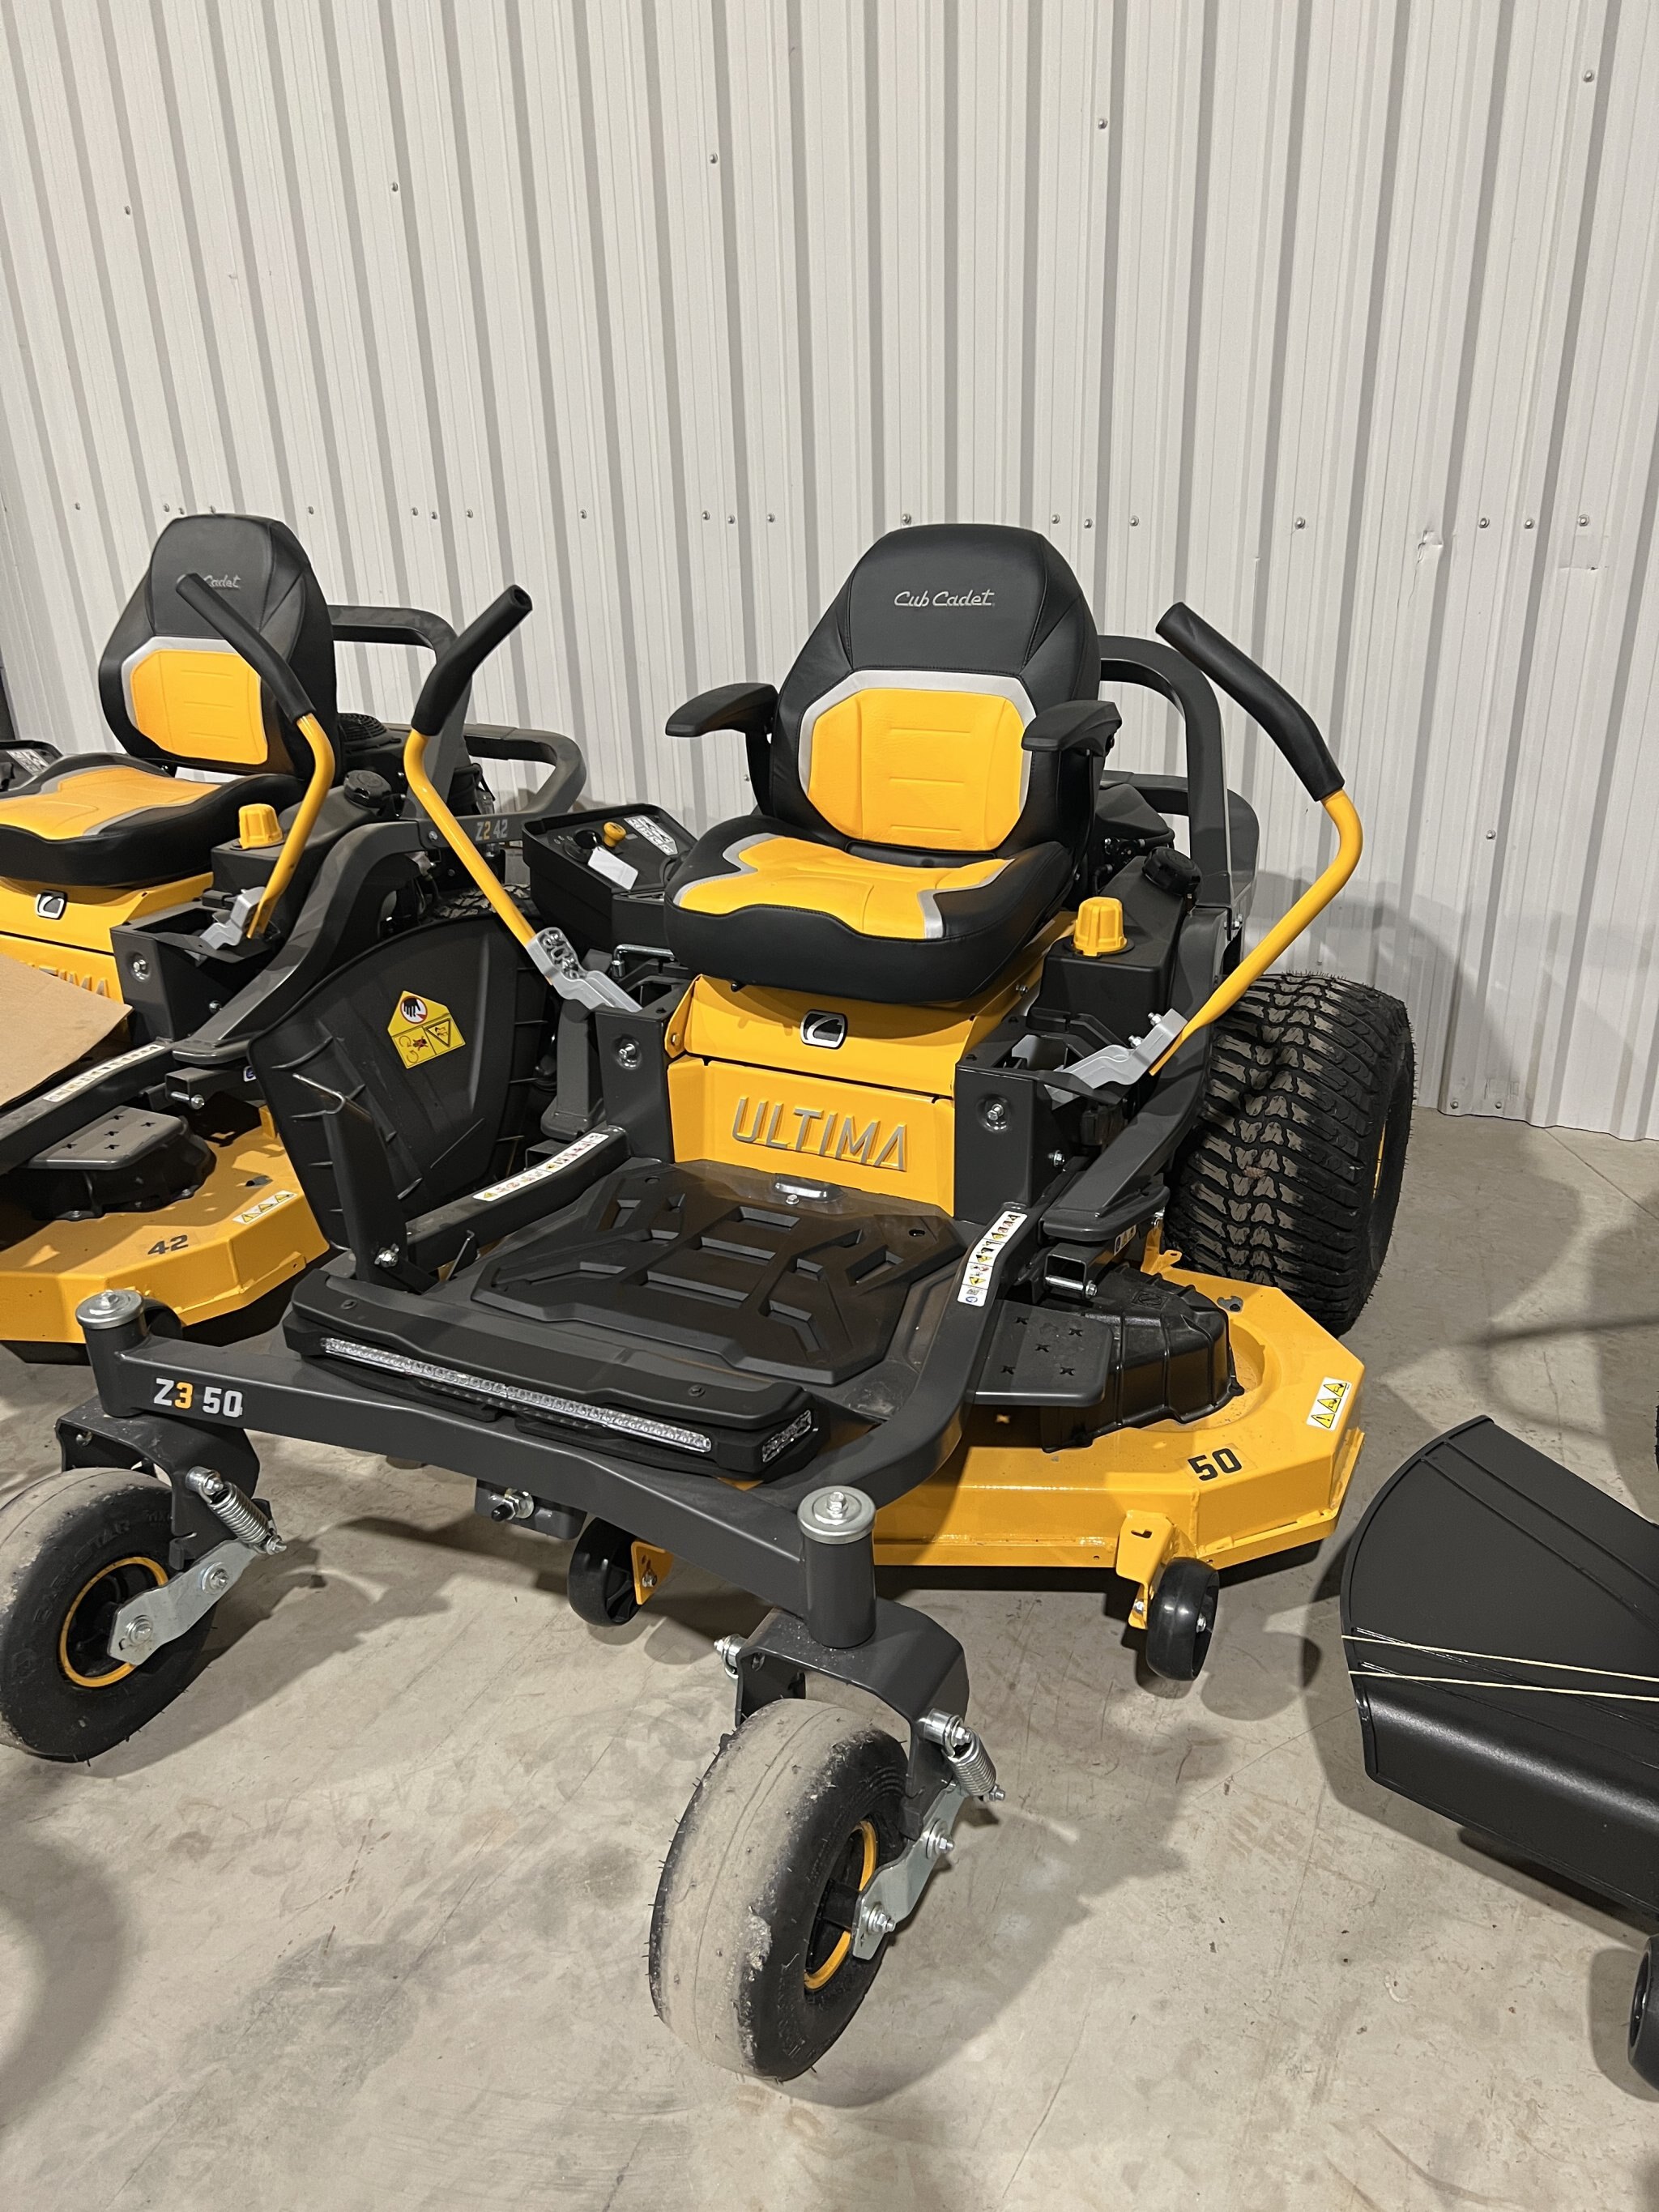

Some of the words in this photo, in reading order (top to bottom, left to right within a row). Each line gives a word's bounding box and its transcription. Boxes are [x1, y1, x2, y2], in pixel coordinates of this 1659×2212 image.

[893, 590, 930, 607] Cub
[932, 589, 996, 607] Cadet
[475, 820, 492, 842] Z2
[493, 819, 508, 839] 42
[731, 1095, 907, 1172] ULTIMA
[147, 1234, 189, 1255] 42
[153, 1378, 194, 1409] Z3
[202, 1386, 243, 1418] 50
[1187, 1448, 1243, 1481] 50
